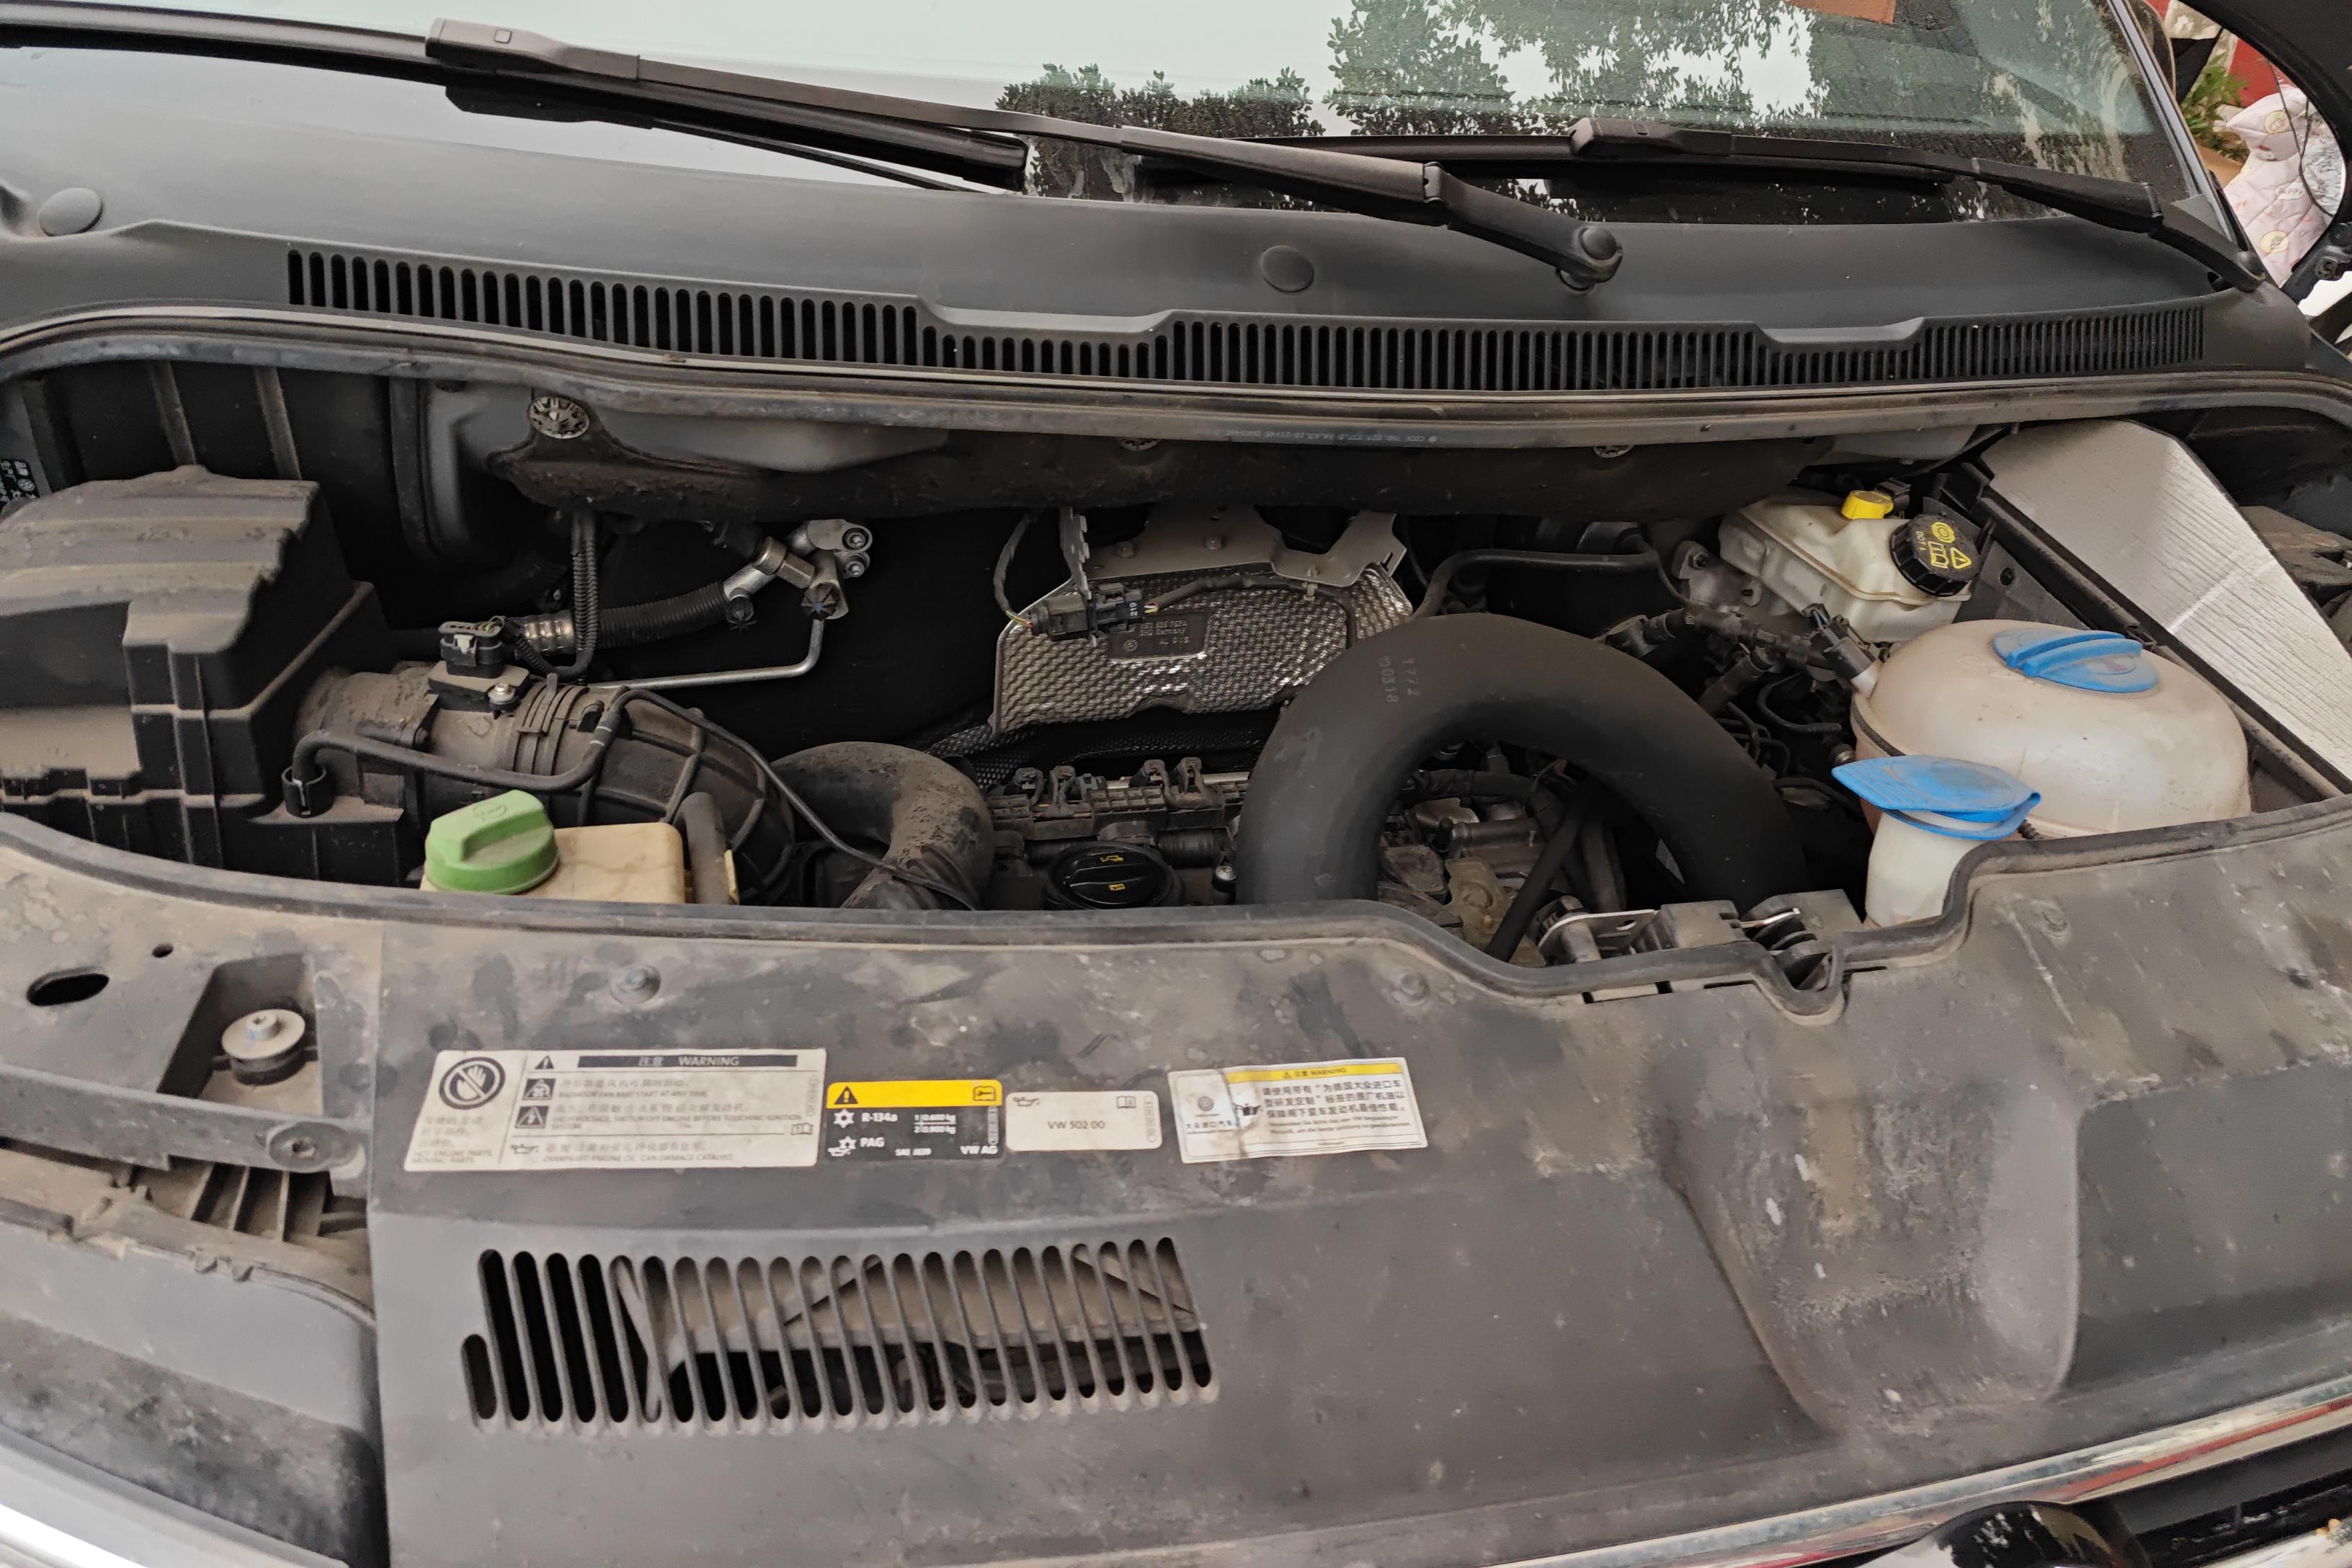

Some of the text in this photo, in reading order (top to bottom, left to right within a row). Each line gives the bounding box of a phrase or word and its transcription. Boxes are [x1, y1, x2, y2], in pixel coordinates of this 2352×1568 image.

[678, 1056, 740, 1066] WARNING
[860, 1112, 899, 1123] R-134a
[1047, 1121, 1106, 1129] VW 502 00
[860, 1137, 886, 1148] PAG
[960, 1146, 998, 1155] VW AG
